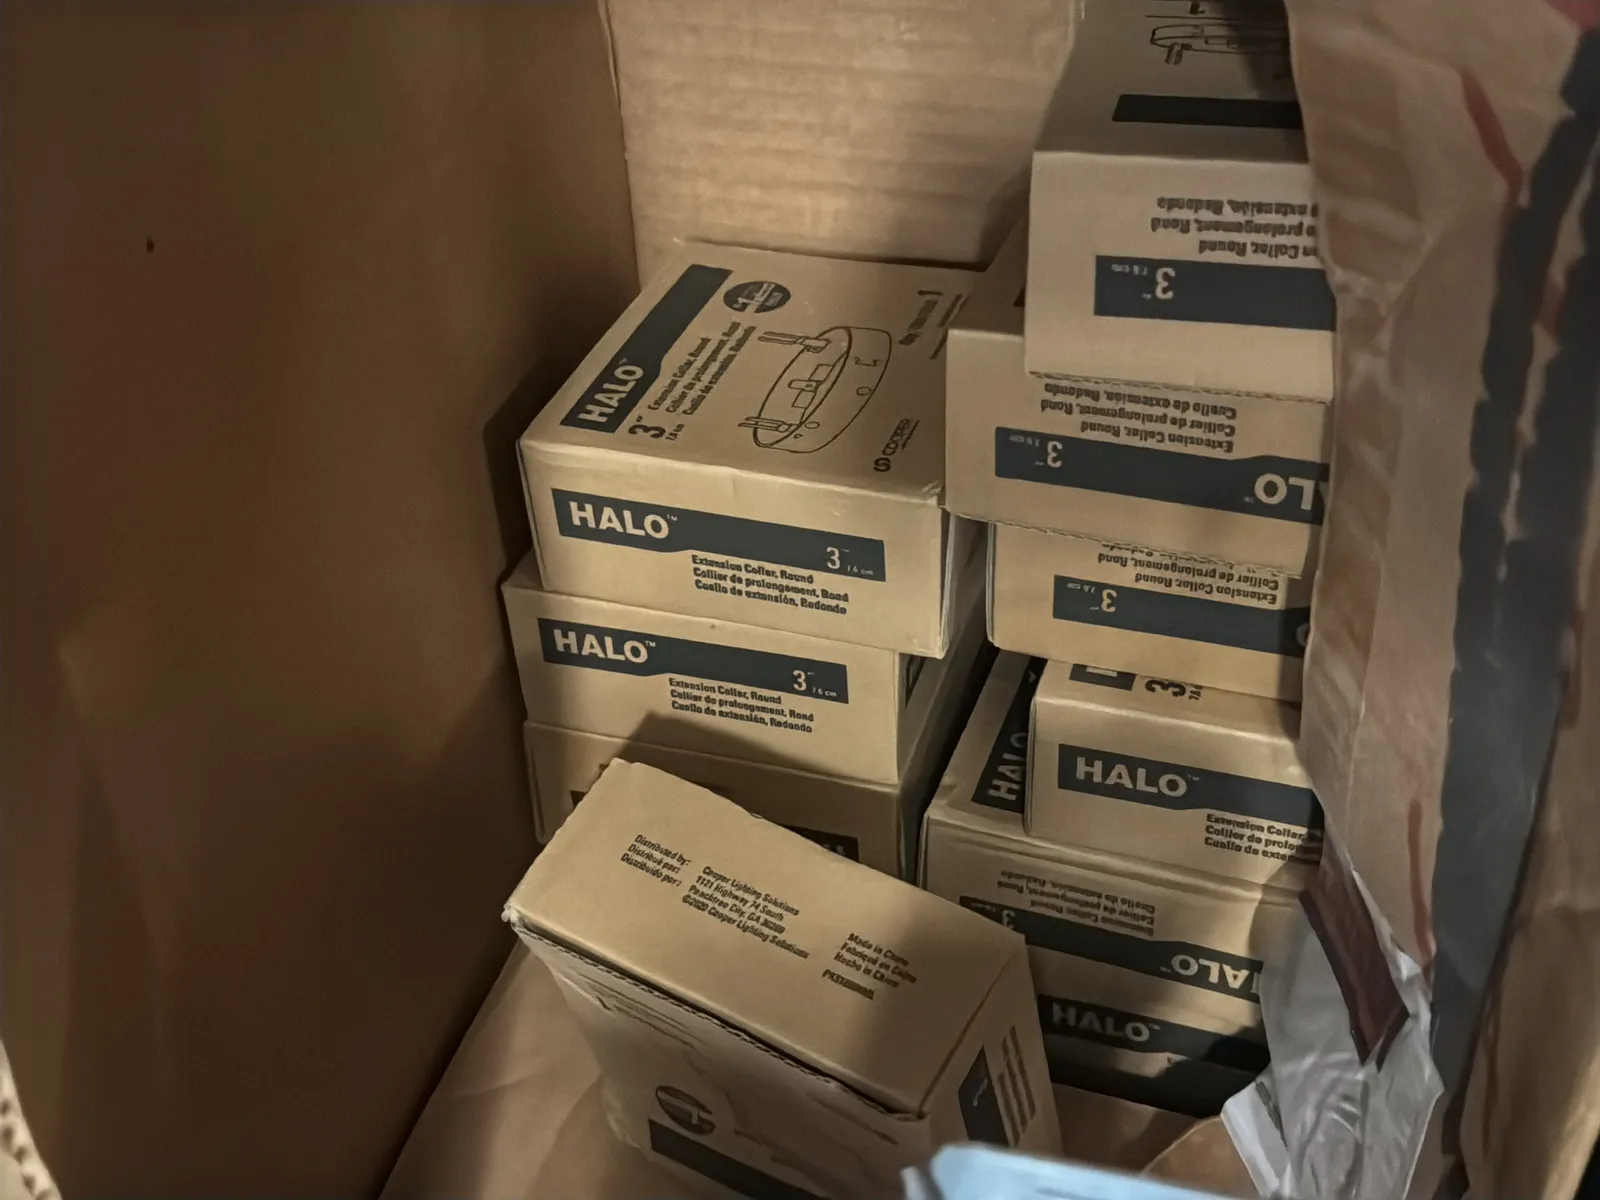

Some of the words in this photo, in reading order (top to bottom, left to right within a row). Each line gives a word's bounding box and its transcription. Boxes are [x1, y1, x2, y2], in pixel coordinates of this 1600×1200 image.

[1040, 399, 1073, 416] Rond
[1173, 400, 1191, 413] de
[1080, 420, 1120, 438] Round
[1170, 417, 1188, 429] de
[1190, 418, 1236, 438] Collier
[1167, 433, 1234, 453] Extension
[1253, 472, 1314, 511] LO
[692, 555, 742, 572] Extension
[780, 570, 814, 584] Round
[1098, 552, 1128, 568] Rond
[693, 567, 727, 582] Collier
[730, 573, 743, 584] de
[745, 576, 819, 598] prolongement,
[821, 589, 849, 602] Rond
[1135, 572, 1172, 588] Round
[1219, 570, 1235, 583] de
[1237, 573, 1279, 591] Collier
[695, 579, 728, 594] Cuello
[730, 586, 743, 596] de
[801, 600, 847, 615] Redondo
[1216, 586, 1277, 605] Extension
[669, 677, 716, 694] Extension
[751, 691, 782, 705] Round
[824, 689, 837, 697] cm
[670, 689, 702, 702] Collier
[704, 694, 717, 705] de
[718, 698, 787, 718] prolongement,
[789, 709, 814, 722] Rond
[672, 700, 702, 713] Cuello
[704, 706, 717, 716] de
[770, 717, 812, 733] Redondo
[1206, 813, 1265, 833] Extension
[1205, 825, 1245, 840] Collier
[1247, 833, 1262, 844] de
[627, 844, 663, 866] Distribué
[634, 834, 679, 860] Distributed
[1204, 836, 1242, 852] Cuello
[1244, 845, 1259, 855] de
[620, 853, 662, 879] Distribuido
[689, 885, 729, 909] Peachtree
[696, 876, 714, 889] 1121
[714, 883, 750, 907] Highway
[760, 905, 784, 921] South
[702, 866, 731, 884] Cooper
[731, 879, 762, 899] Lighting
[762, 894, 800, 916] Solutions
[708, 907, 736, 925] Cooper
[736, 920, 770, 942] Lighting
[769, 935, 810, 959] Solutions
